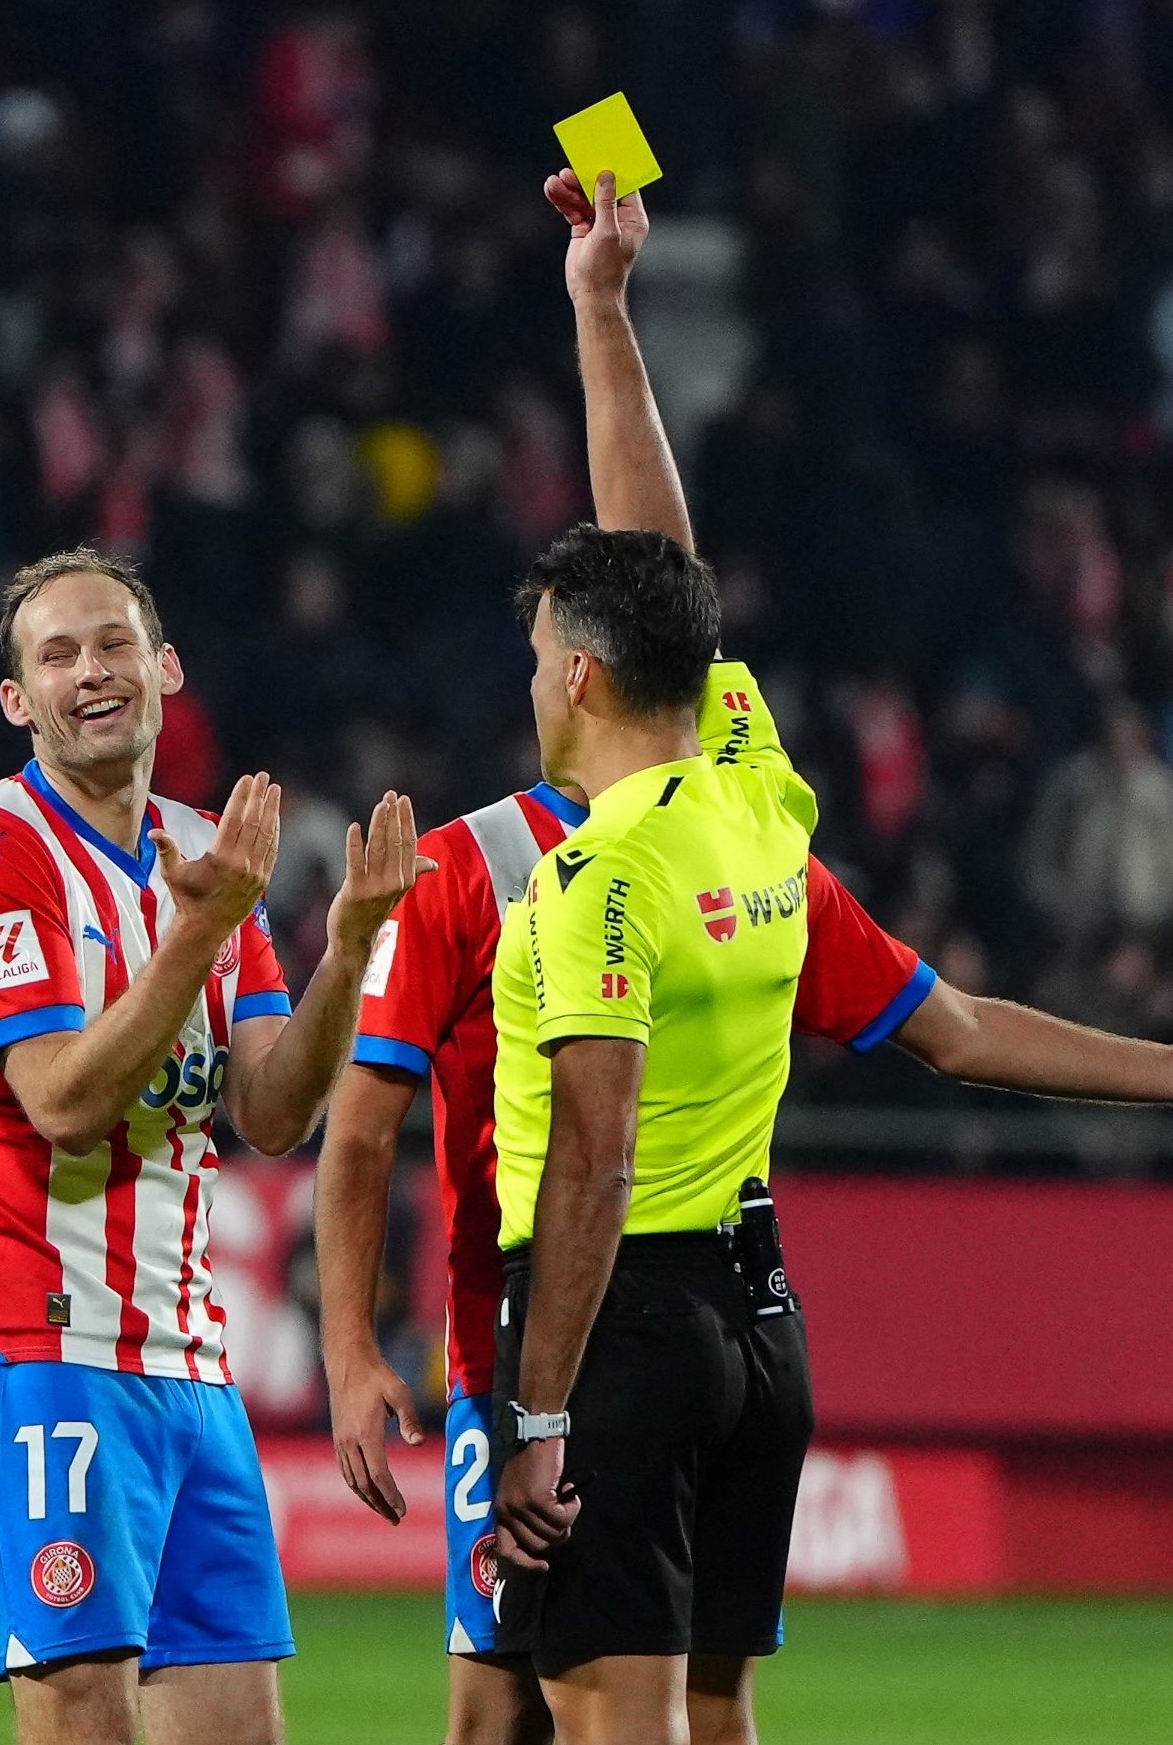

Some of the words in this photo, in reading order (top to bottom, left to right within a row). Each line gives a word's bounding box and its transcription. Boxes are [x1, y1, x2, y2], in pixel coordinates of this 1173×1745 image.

[604, 878, 631, 966] WÜRTH
[740, 862, 808, 927] WÜRT
[14, 1421, 99, 1520] 17
[451, 1428, 491, 1522] 2
[39, 1546, 79, 1564] GIRONA
